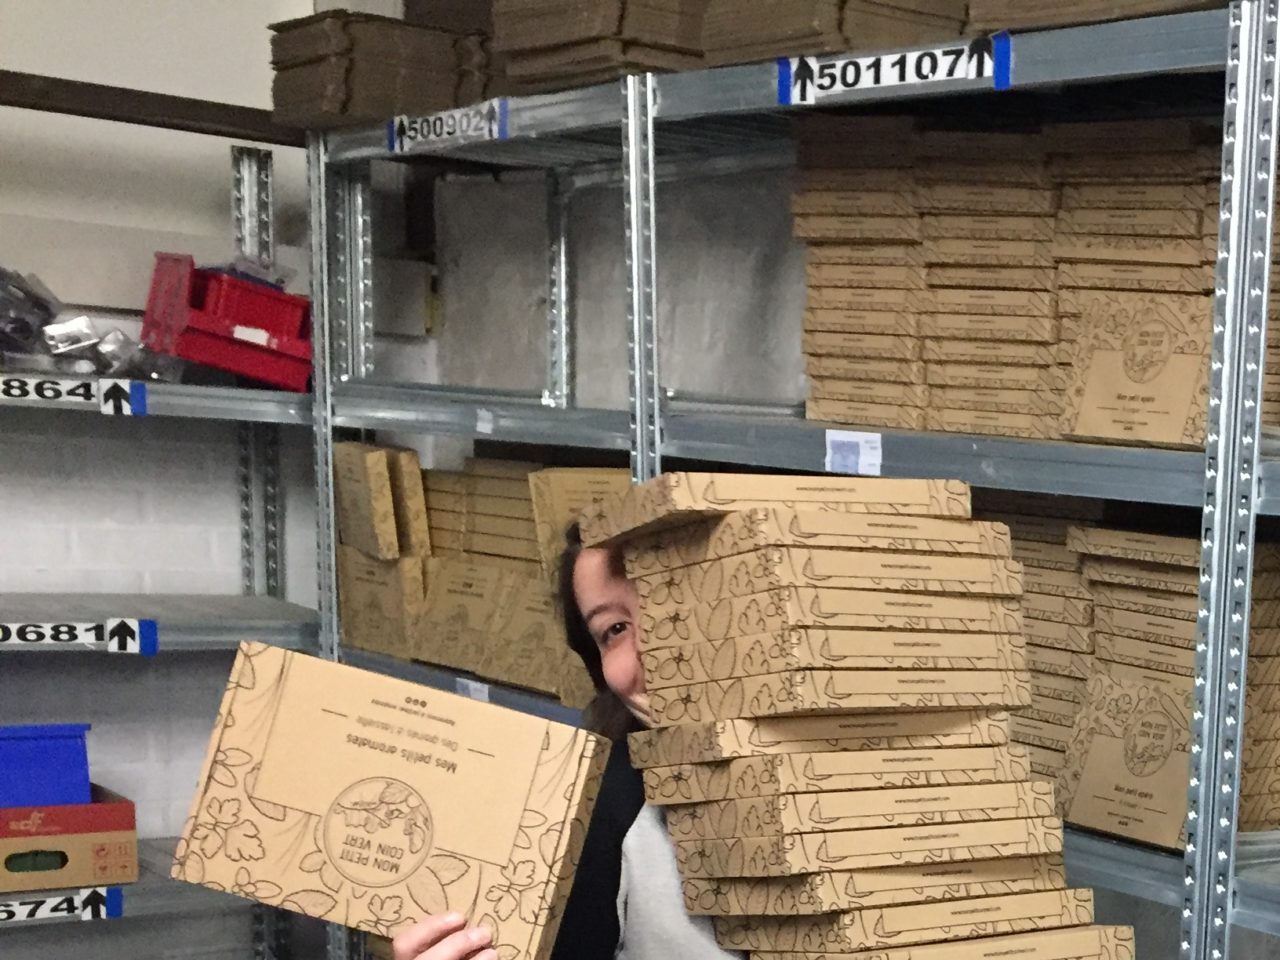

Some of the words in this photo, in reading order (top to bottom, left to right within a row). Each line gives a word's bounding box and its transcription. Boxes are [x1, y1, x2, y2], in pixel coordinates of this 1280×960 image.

[817, 48, 966, 91] 501107
[407, 110, 485, 140] 500902
[346, 733, 398, 755] aromates
[400, 749, 432, 764] petits
[435, 758, 458, 774] Mes
[342, 834, 371, 851] VERT
[340, 848, 369, 866] PETIT
[376, 843, 404, 860] COIN
[372, 858, 400, 874] MON
